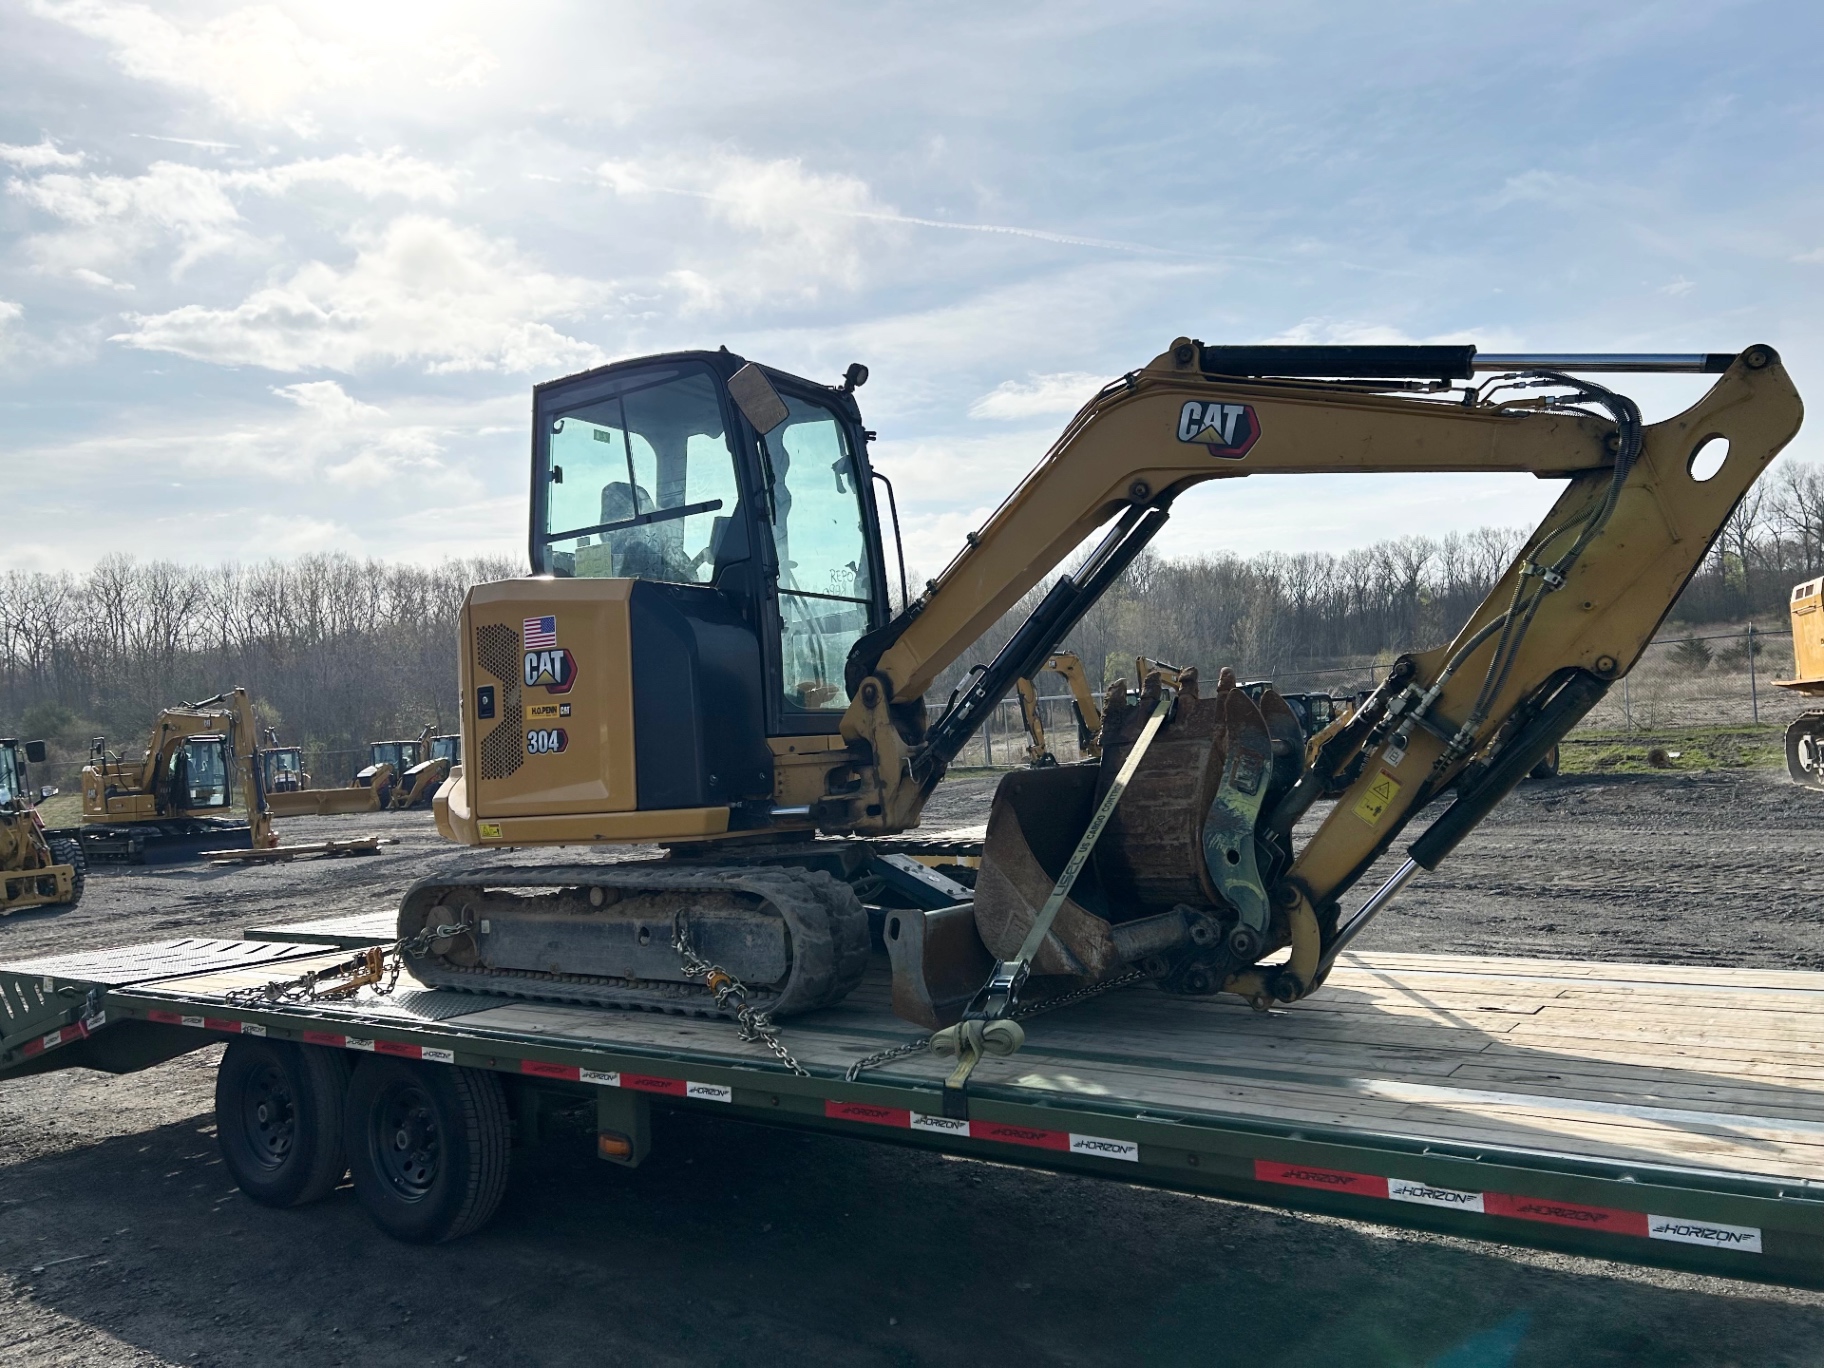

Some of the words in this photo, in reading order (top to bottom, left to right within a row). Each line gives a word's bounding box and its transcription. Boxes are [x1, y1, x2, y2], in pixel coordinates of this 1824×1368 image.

[1179, 402, 1244, 445] CAT
[829, 568, 853, 583] REPO
[525, 650, 564, 686] CAT
[560, 706, 571, 715] CAT
[528, 730, 560, 754] 304
[1078, 842, 1091, 854] US
[1086, 815, 1106, 840] CARGO
[694, 1087, 724, 1097] HORIZON
[848, 1106, 885, 1119] HORIZON
[920, 1116, 959, 1130] HORIZON
[998, 1127, 1041, 1140] HORIZON
[1080, 1140, 1129, 1154] HORIZON
[1288, 1169, 1348, 1185] HORIZON
[1402, 1186, 1469, 1204] HORIZON
[1526, 1203, 1600, 1222] HORIZON
[1663, 1223, 1745, 1244] HORIZON
